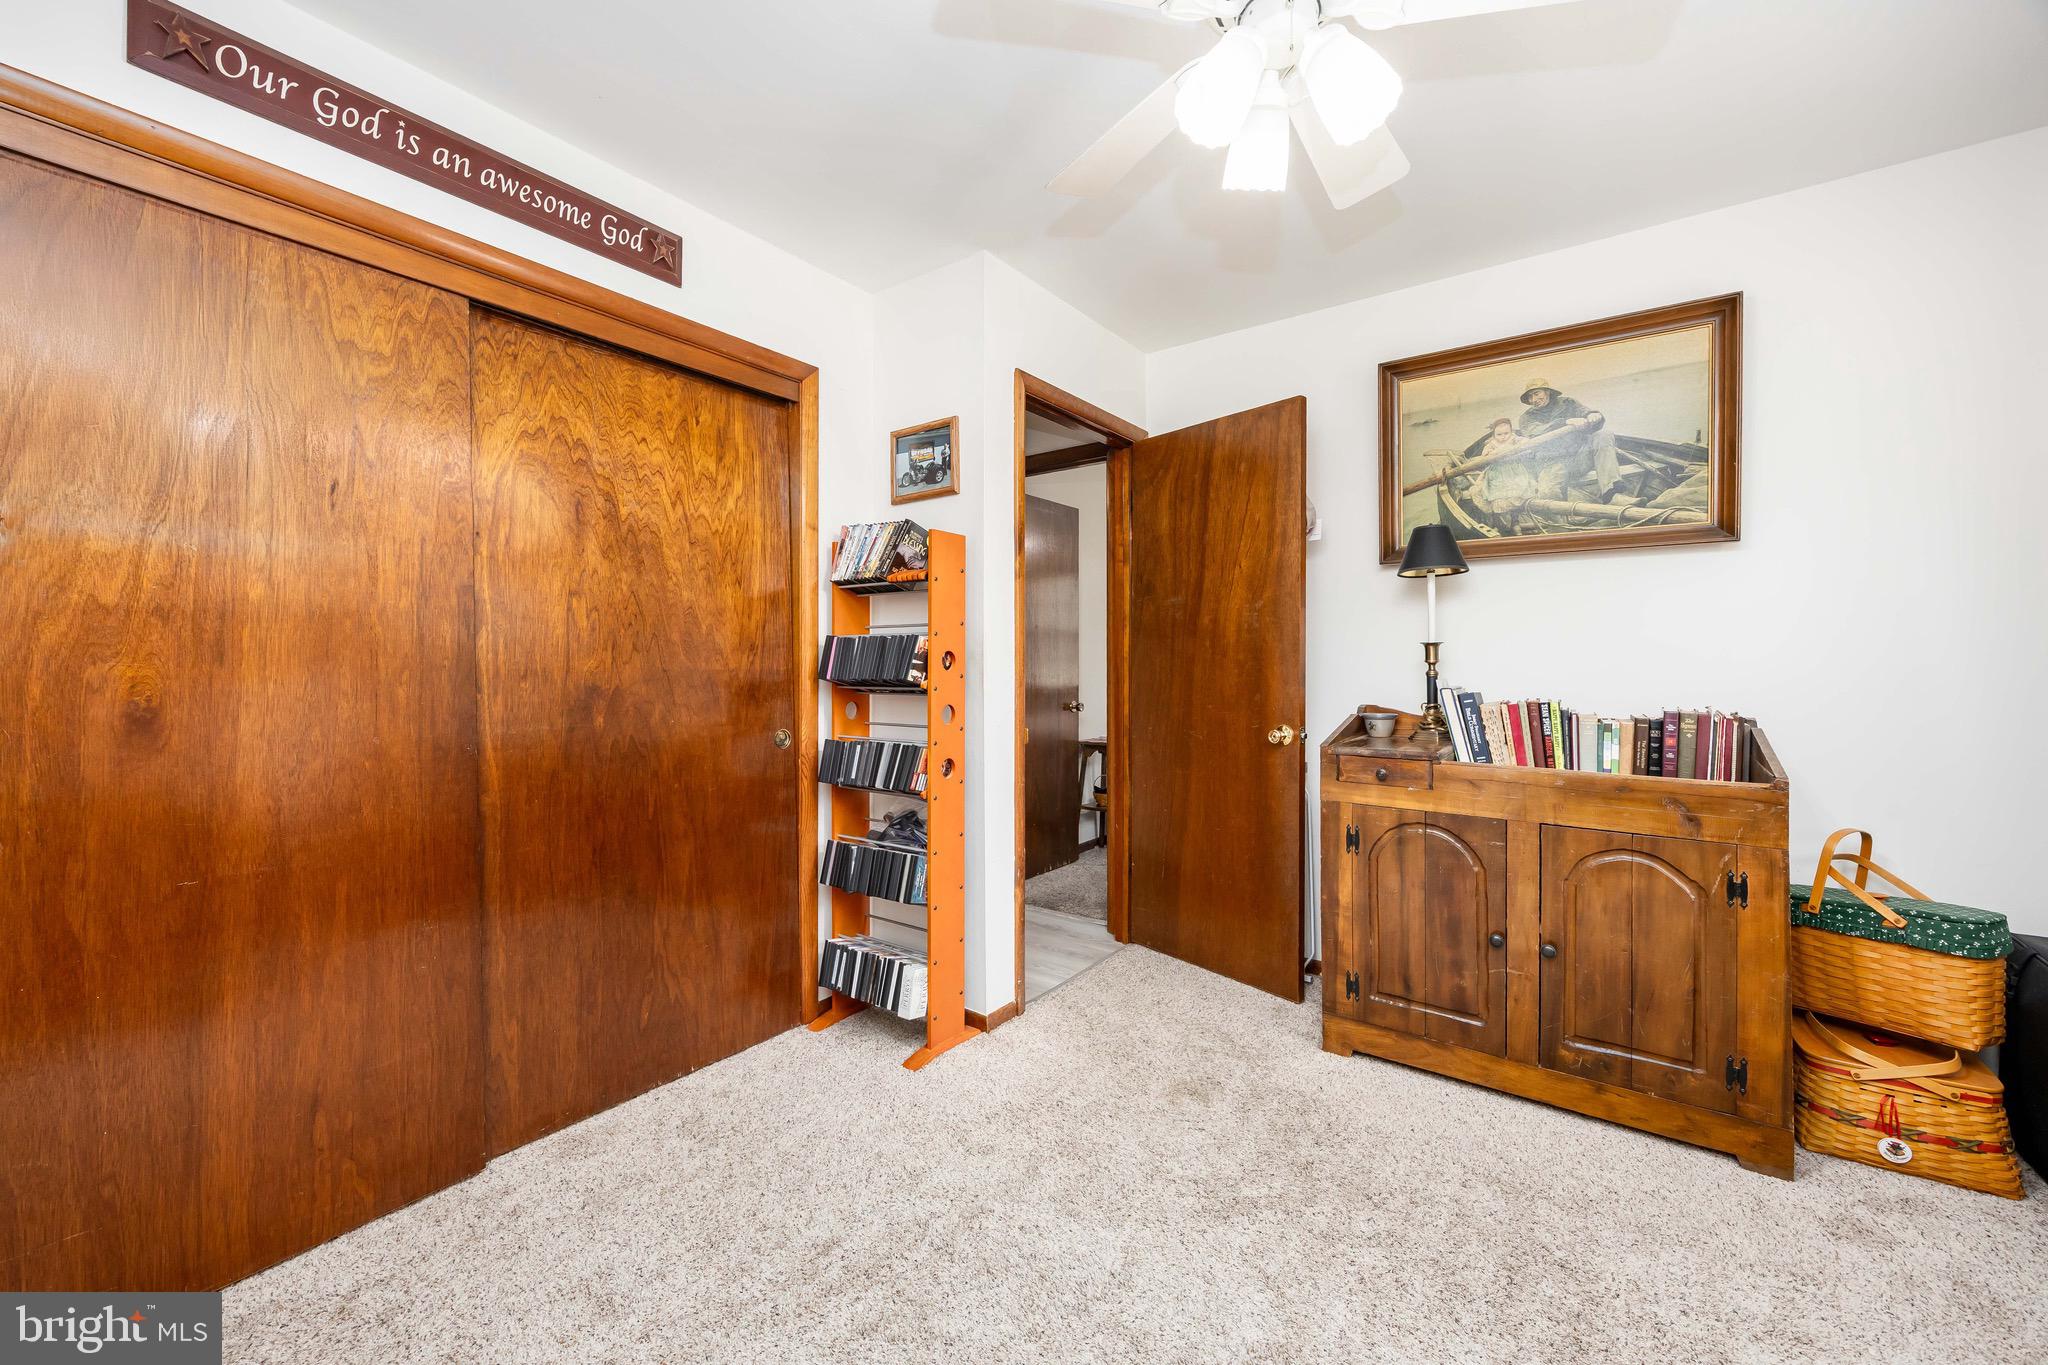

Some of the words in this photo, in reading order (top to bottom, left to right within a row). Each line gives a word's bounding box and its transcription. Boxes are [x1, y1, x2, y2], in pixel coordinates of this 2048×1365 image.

[215, 44, 299, 99] Our
[312, 87, 390, 140] God
[395, 120, 421, 156] is
[432, 147, 472, 178] an
[480, 168, 592, 229] awesome
[600, 214, 649, 252] God
[1541, 703, 1549, 717] SEAN
[1543, 717, 1551, 736] SPICER
